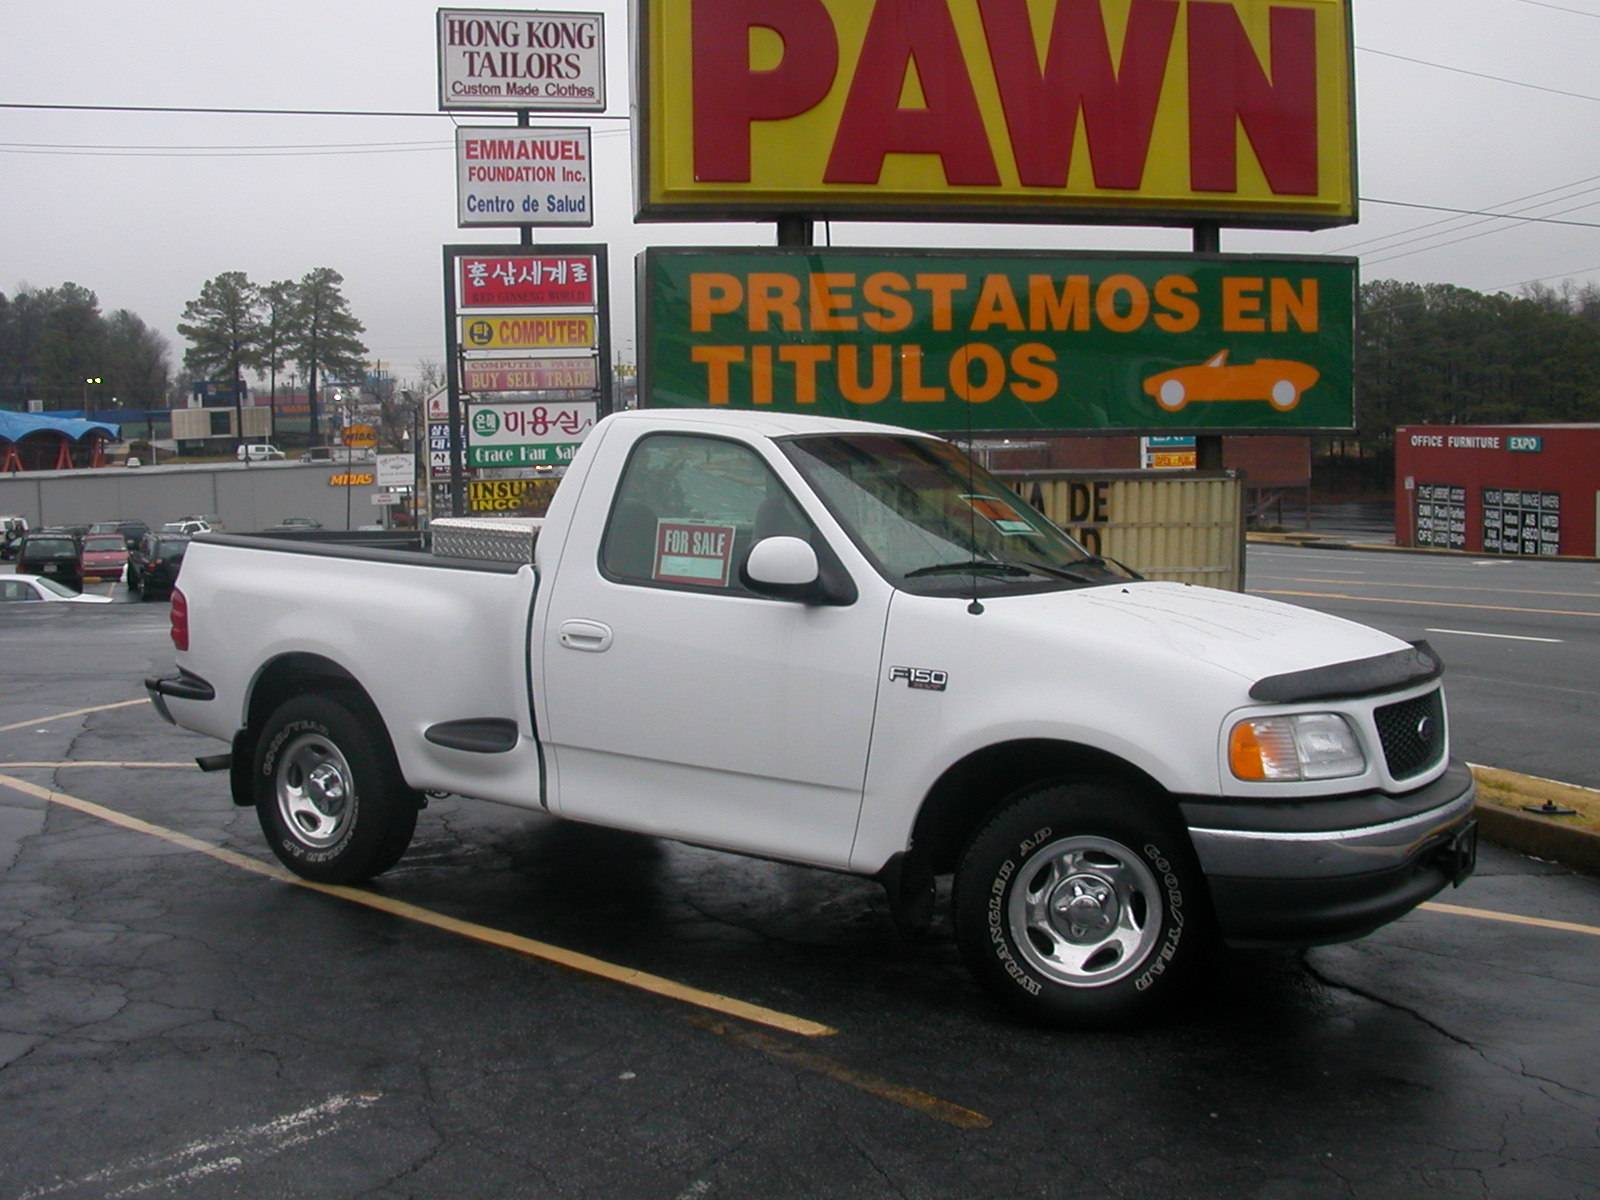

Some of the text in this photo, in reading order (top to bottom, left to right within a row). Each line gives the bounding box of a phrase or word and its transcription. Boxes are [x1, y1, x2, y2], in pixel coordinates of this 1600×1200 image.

[448, 19, 595, 49] HONG KONG
[463, 51, 581, 80] TAILORS
[451, 80, 595, 97] Custom Made Clothes
[693, 0, 1320, 196] PAWN
[465, 139, 586, 161] EMMANUEL
[468, 166, 586, 183] FOUNDATION Inc.
[466, 194, 586, 213] Centro de Salud
[467, 260, 588, 287] 홍삼세계로
[690, 273, 1320, 334] PRESTAMOS EN
[500, 319, 589, 344] COMPUTER
[471, 361, 544, 369] COMPUTER
[691, 343, 1059, 405] TITULOS
[471, 371, 499, 389] BUY
[507, 370, 538, 388] SELL
[545, 369, 592, 387] TRADE
[503, 406, 592, 437] 미용실
[475, 447, 513, 463] Grace
[519, 446, 547, 461] Hair
[1410, 436, 1537, 451] OFFICE FURNITURE EXPO
[330, 473, 374, 487] MIDAS
[1071, 483, 1108, 522] DE
[664, 529, 726, 557] FOR SALE
[889, 666, 948, 685] F-150
[988, 859, 1042, 996] WRANGLER
